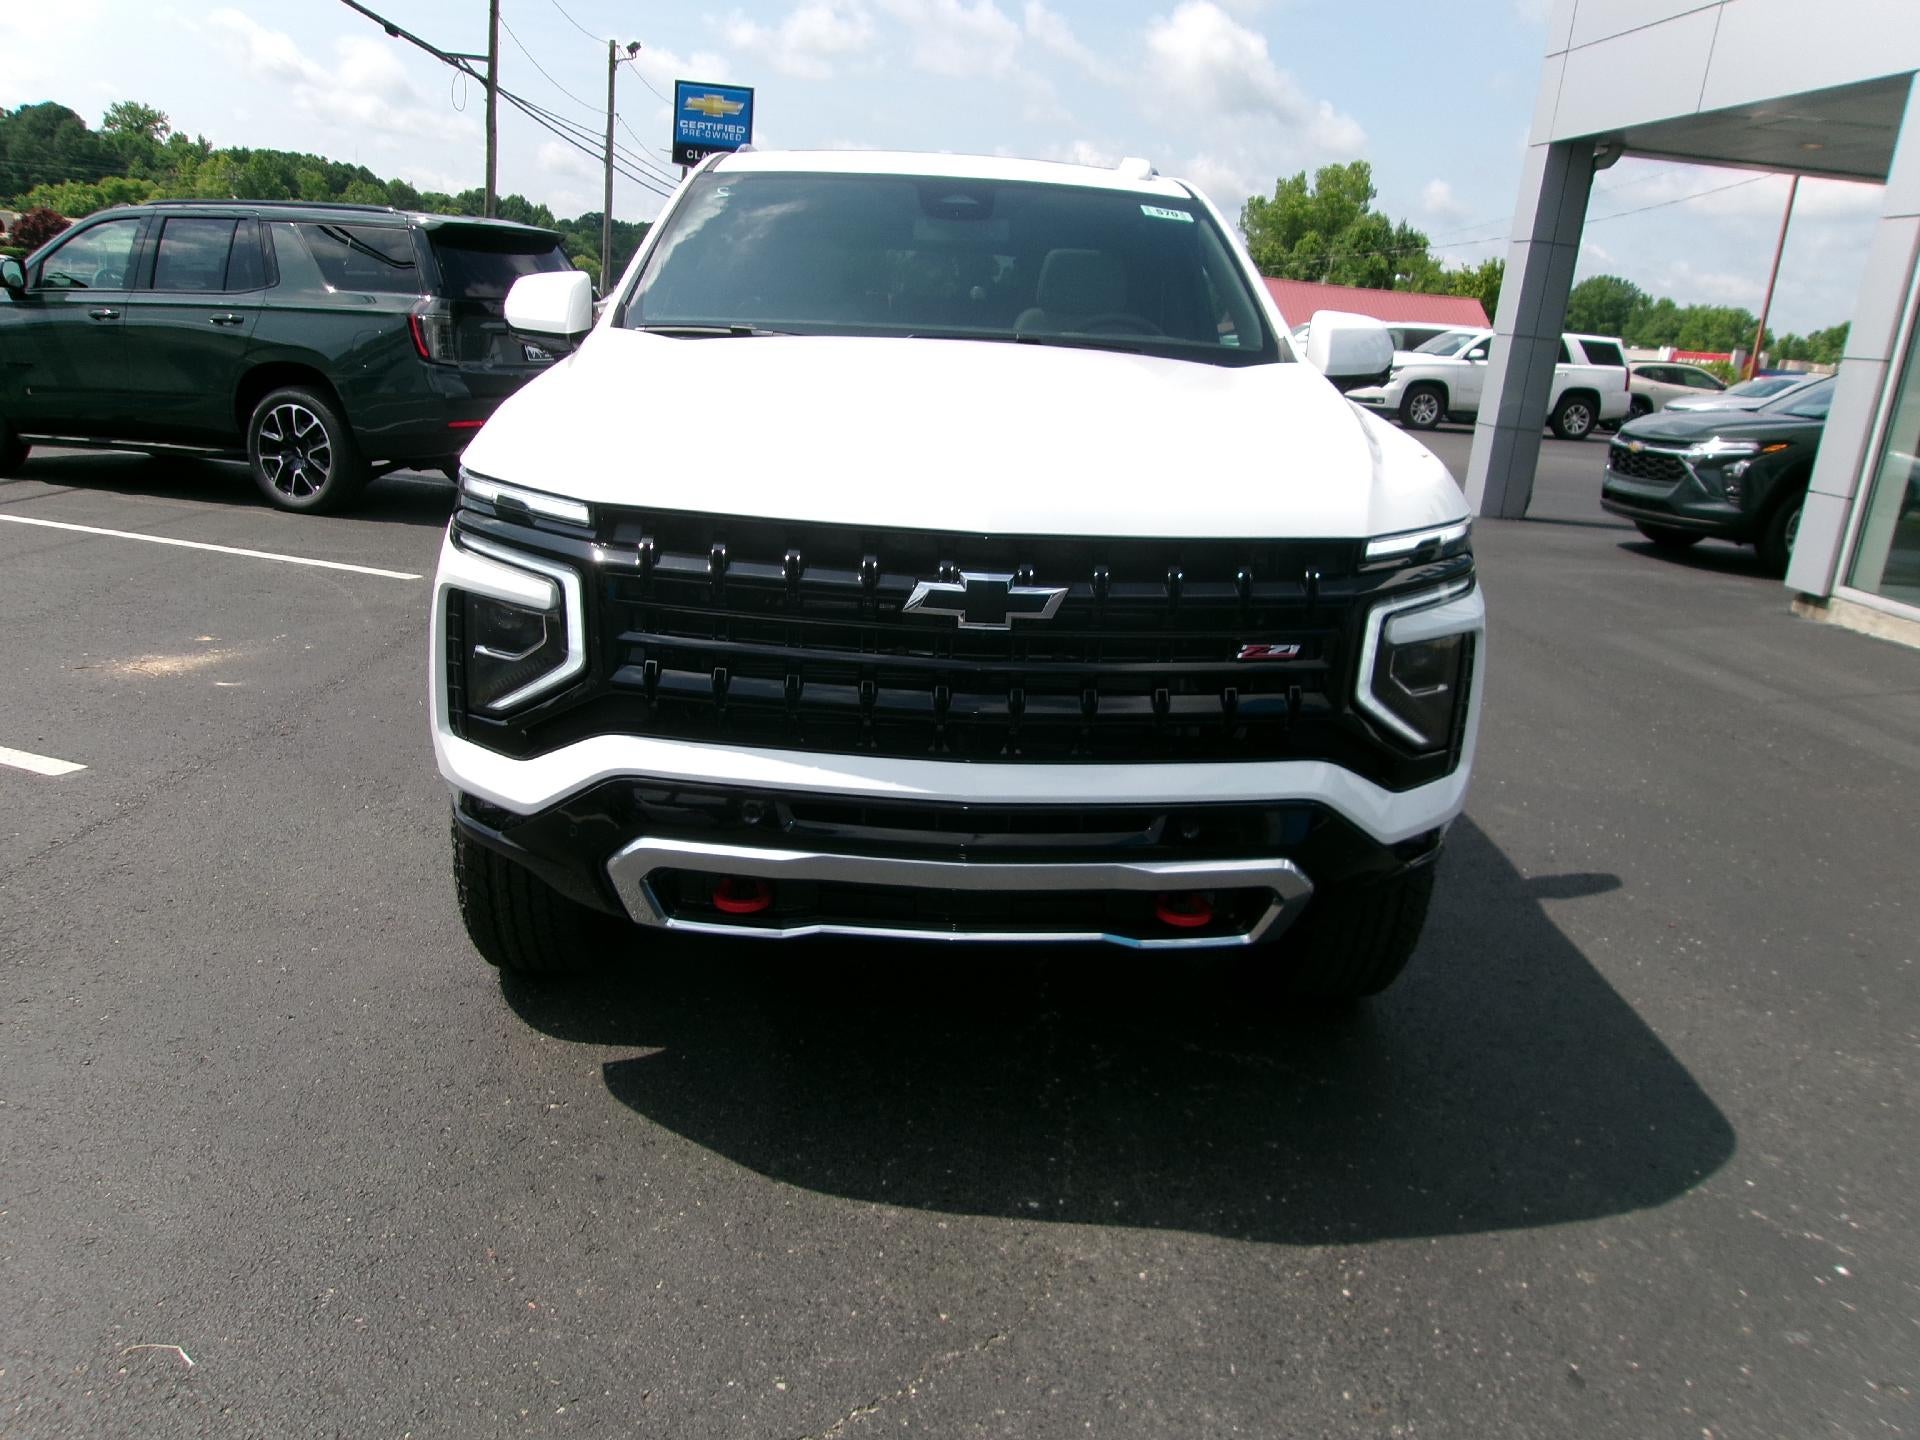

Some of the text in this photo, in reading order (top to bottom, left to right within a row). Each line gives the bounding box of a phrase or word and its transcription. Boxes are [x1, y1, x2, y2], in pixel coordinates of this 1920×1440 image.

[679, 119, 746, 134] CERTIFIED
[682, 128, 742, 142] PRE-OWNED
[686, 149, 711, 160] CLA
[1236, 643, 1301, 660] Z71
